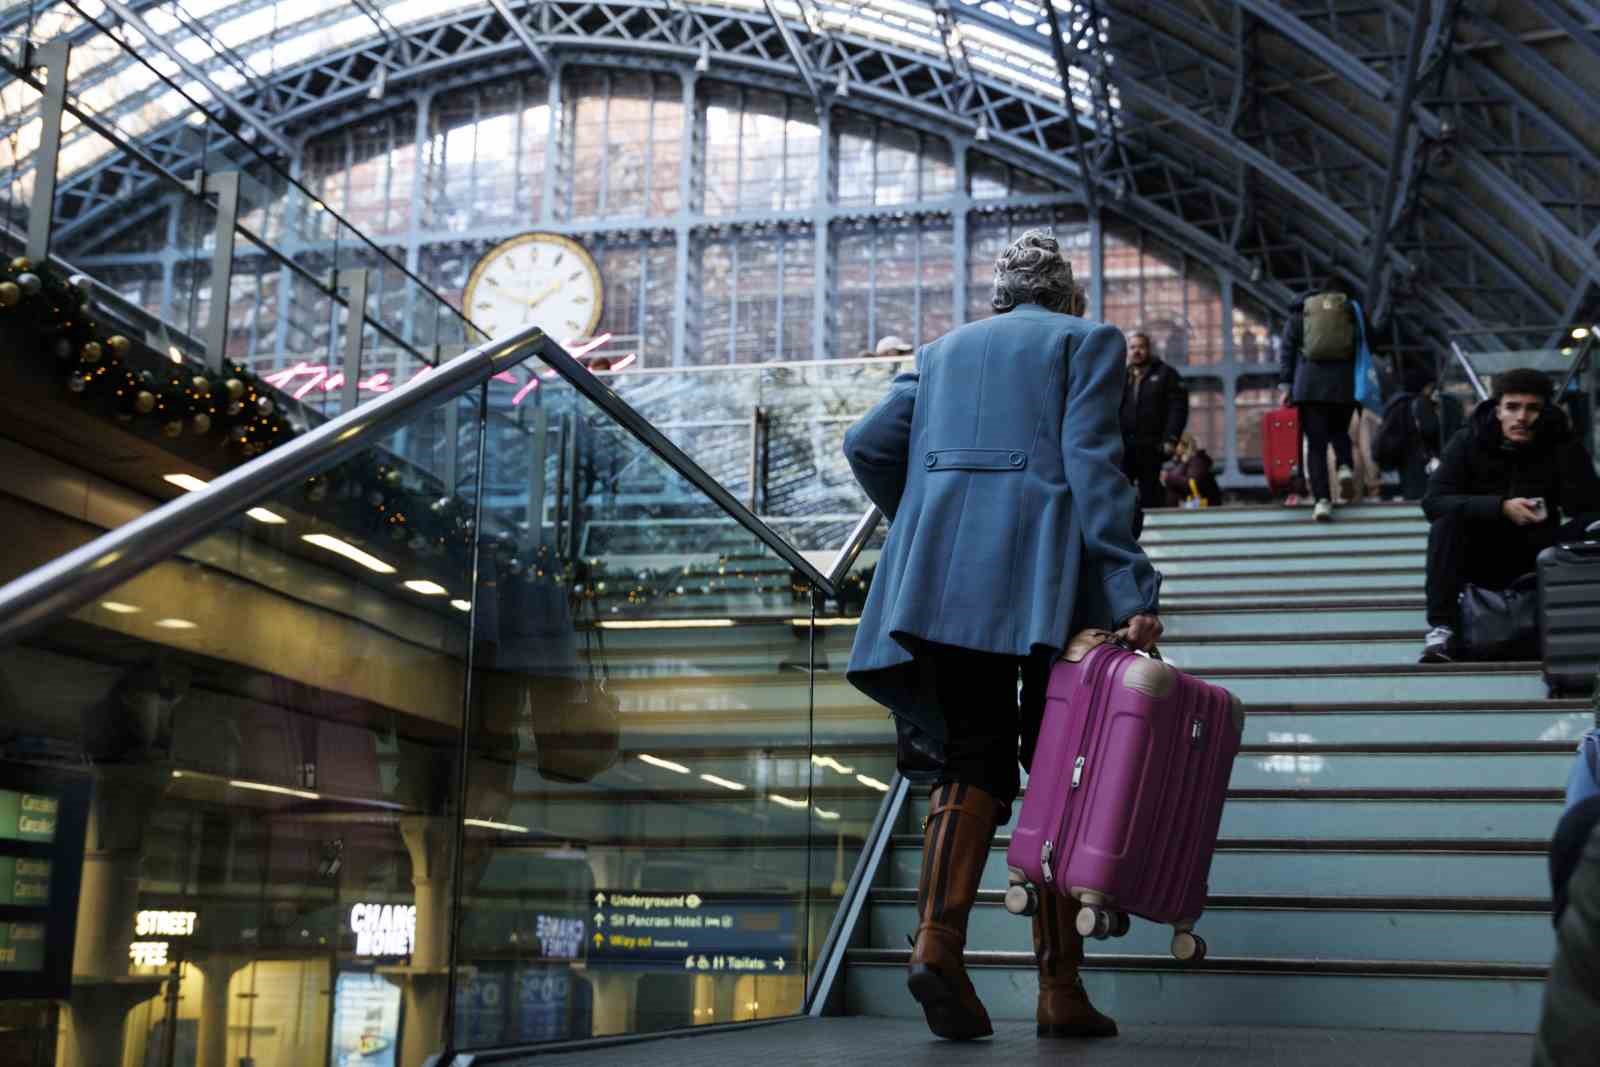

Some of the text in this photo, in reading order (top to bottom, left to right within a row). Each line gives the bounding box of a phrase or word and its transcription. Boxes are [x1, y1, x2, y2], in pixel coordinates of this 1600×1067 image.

[610, 894, 685, 910] Underground
[135, 910, 197, 936] STREET
[350, 903, 417, 933] CHANG
[610, 914, 703, 928] St Pancras Hotel
[609, 934, 636, 949] Way
[727, 955, 767, 970] Toilets
